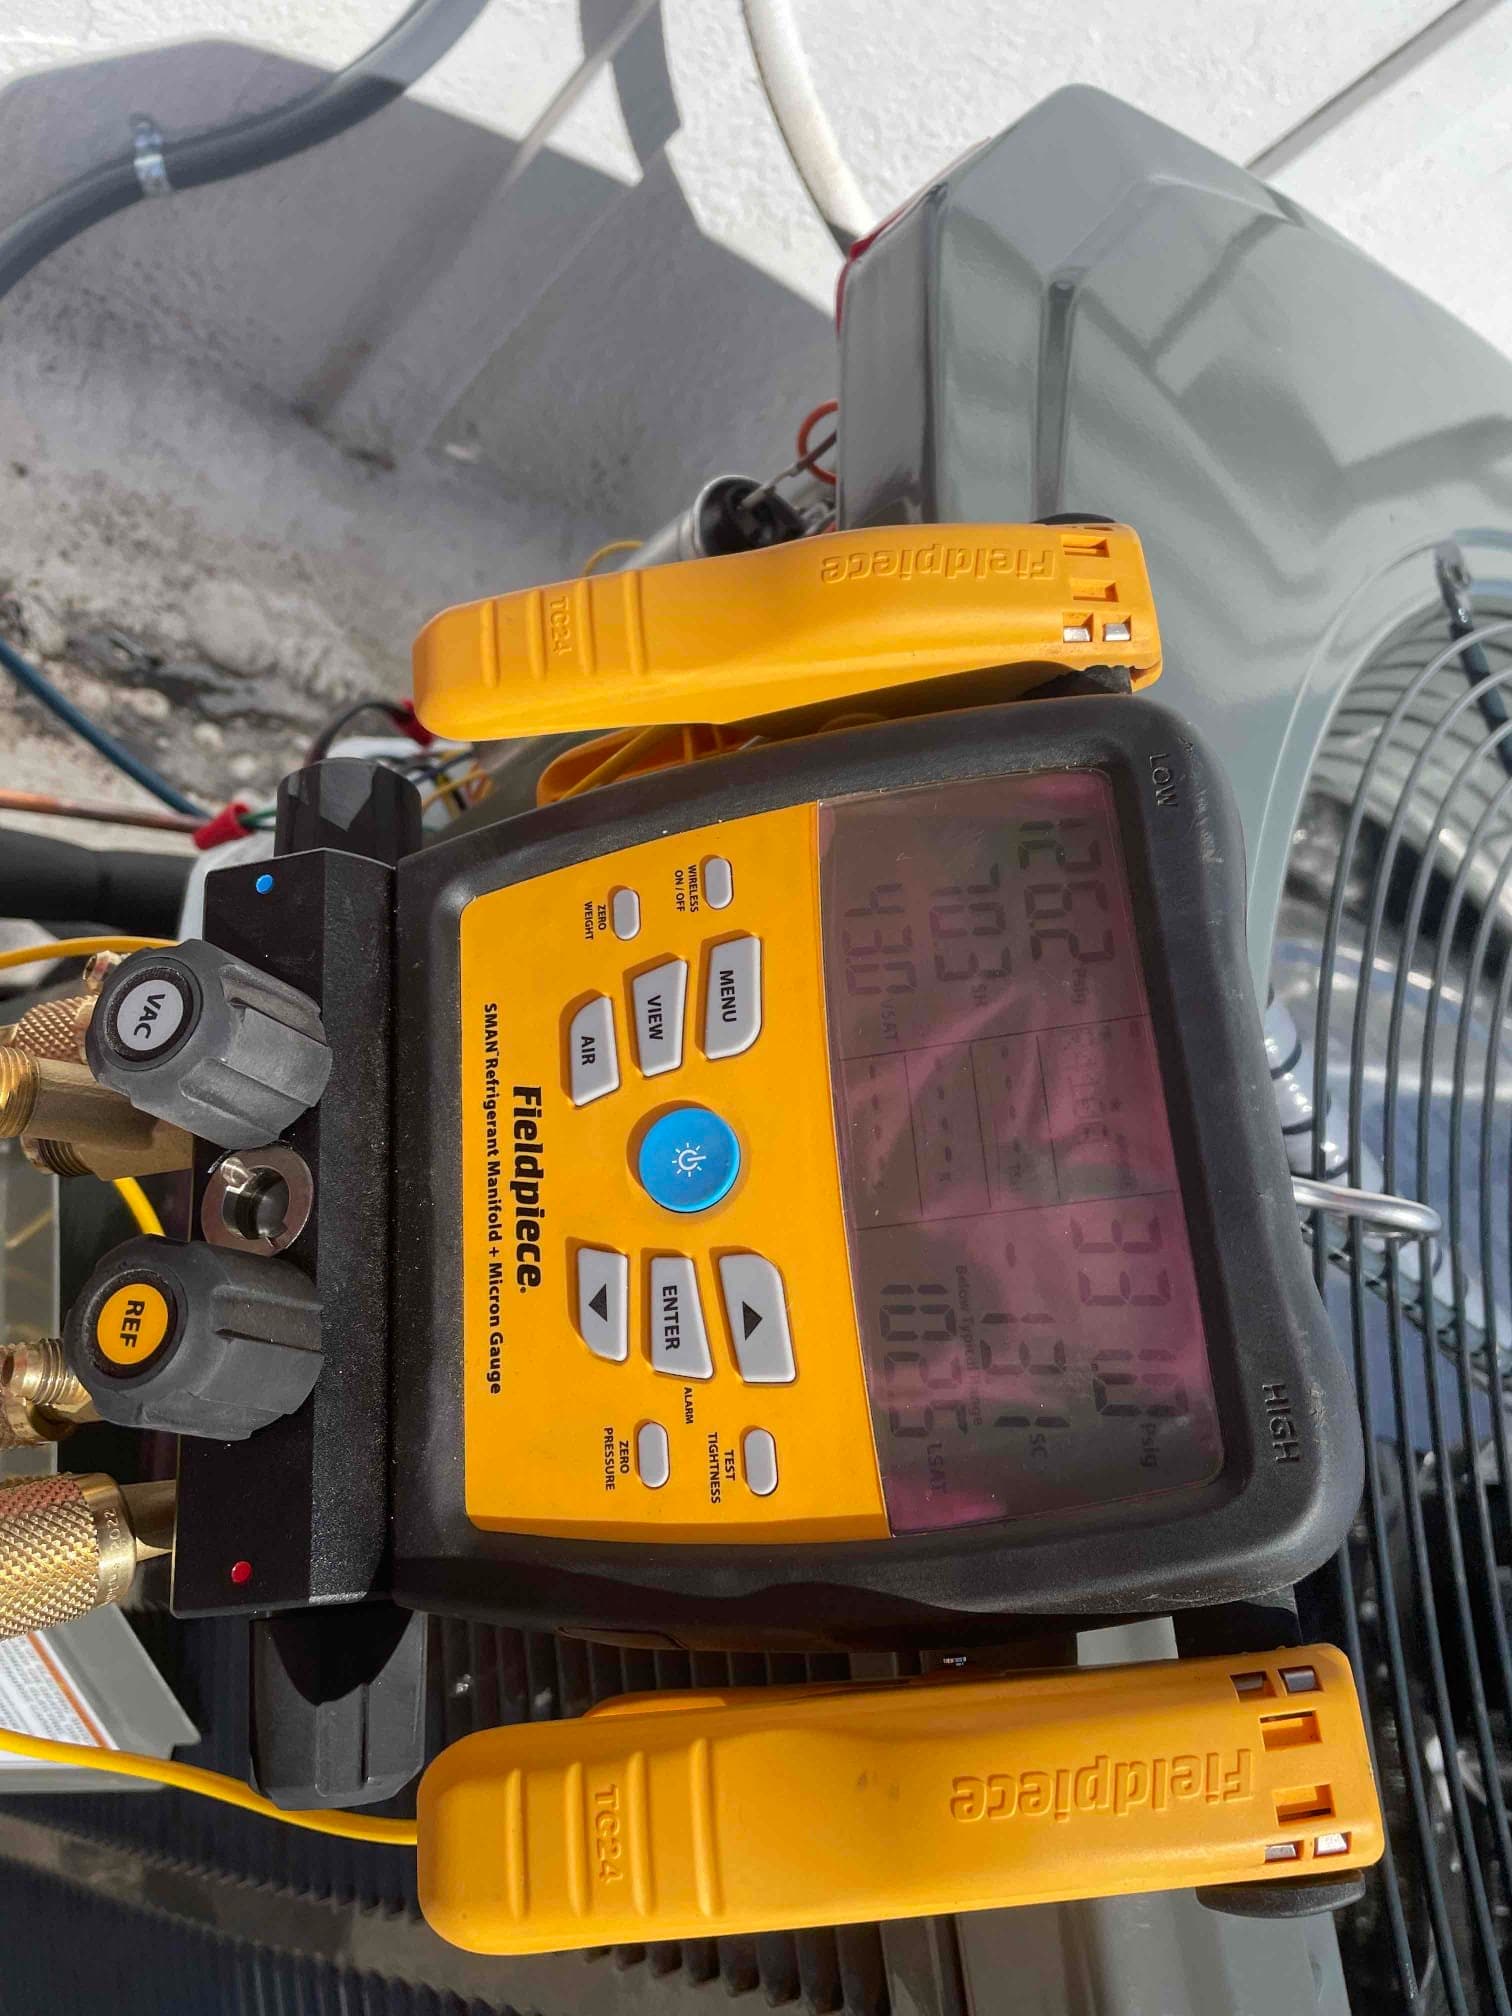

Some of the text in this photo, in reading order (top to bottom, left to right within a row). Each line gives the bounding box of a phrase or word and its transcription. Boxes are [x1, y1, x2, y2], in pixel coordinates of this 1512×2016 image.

[820, 544, 1055, 584] Fieldpiece
[1149, 753, 1178, 807] LOW
[674, 870, 683, 885] ON
[688, 865, 699, 913] WIRELESS
[583, 901, 594, 940] WEIGHT
[597, 904, 607, 931] ZERO
[675, 894, 685, 913] OFF
[133, 993, 167, 1039] VAC
[646, 995, 663, 1040] VIEW
[719, 970, 736, 1023] MENU
[581, 1036, 595, 1066] AIR
[484, 1058, 500, 1157] Refrigerant
[487, 1161, 503, 1242] Manifold
[489, 1247, 500, 1257] +
[488, 1263, 503, 1327] Micron
[662, 1285, 680, 1351] ENTER
[119, 1300, 146, 1348] REF
[487, 1332, 504, 1394] Gauge
[683, 1387, 694, 1424] ALARM
[1262, 1384, 1301, 1464] HIGH
[603, 1427, 615, 1491] PRESSURE
[618, 1441, 630, 1474] ZERO
[707, 1432, 721, 1504] TIGHTNESS
[724, 1450, 736, 1481] TEST
[950, 1750, 1254, 1822] Fieldpiece
